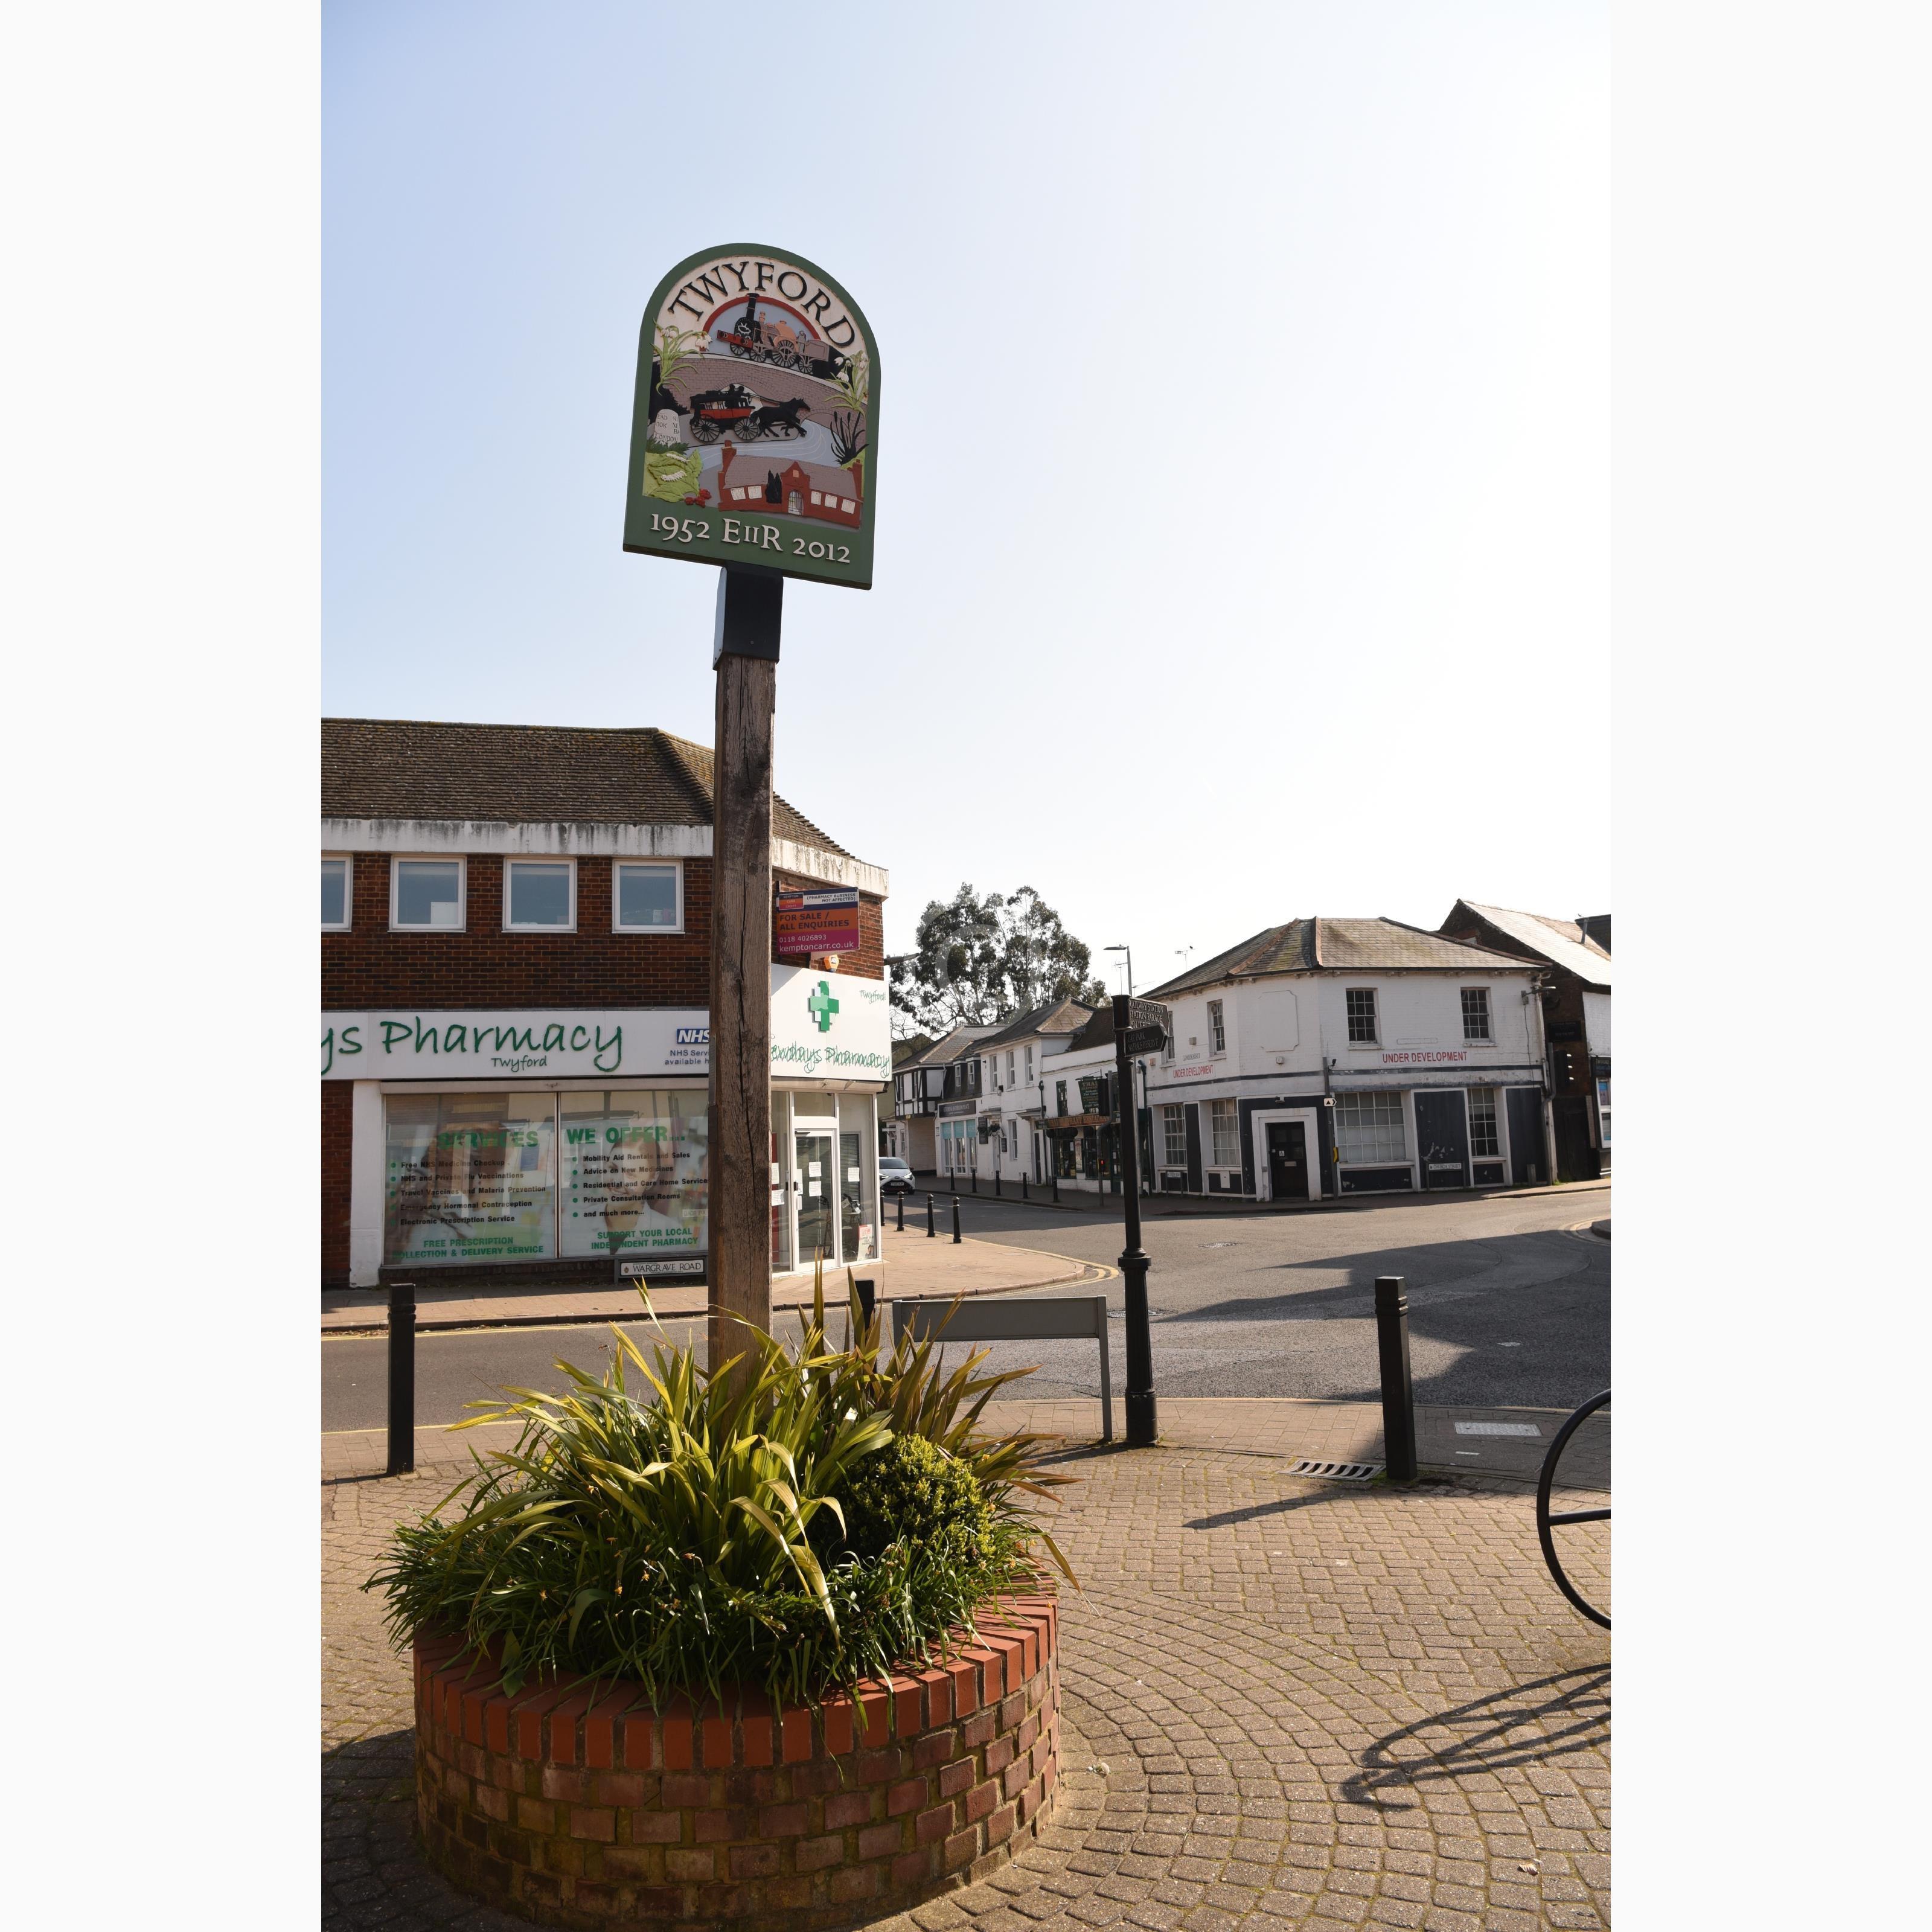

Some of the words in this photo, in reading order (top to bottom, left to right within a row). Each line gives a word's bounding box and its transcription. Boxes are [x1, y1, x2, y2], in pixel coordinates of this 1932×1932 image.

[668, 261, 855, 348] TWYFORD
[650, 514, 710, 543] 1952
[792, 538, 851, 563] 2012
[798, 920, 849, 929] ENQUIRIES
[779, 941, 854, 952] kemptoncarr.co.uk
[1147, 1003, 1163, 1014] STATION
[1147, 1013, 1162, 1023] PARADE
[677, 1029, 710, 1043] NHS
[380, 1015, 622, 1073] Pharmacy
[825, 1045, 890, 1079] Pharmacy
[1382, 1053, 1410, 1063] UNDER
[1412, 1051, 1468, 1063] DEVELOPMENT
[491, 1055, 548, 1073] Twyford
[1173, 1068, 1186, 1078] UNDER
[1186, 1064, 1214, 1076] DEVELOPMENT
[437, 1130, 539, 1150] SERVICES
[566, 1127, 597, 1144] WE
[611, 1194, 655, 1202] Consultation
[481, 1201, 533, 1209] Contraception
[400, 1217, 437, 1226] Electronic
[440, 1216, 485, 1225] Prescription
[597, 1230, 636, 1239] SUPPORT
[639, 1229, 662, 1238] YOUR
[665, 1227, 693, 1236] LOCAL
[423, 1239, 446, 1248] FREE
[450, 1236, 514, 1247] PRESCRIPTION
[591, 1239, 649, 1250] INDEPENDENT
[652, 1238, 699, 1247] PHARMACY
[461, 1247, 503, 1256] DELIVERY
[507, 1246, 544, 1254] SERVICE
[633, 1263, 676, 1272] WARGRAVE
[679, 1262, 701, 1271] ROAD
